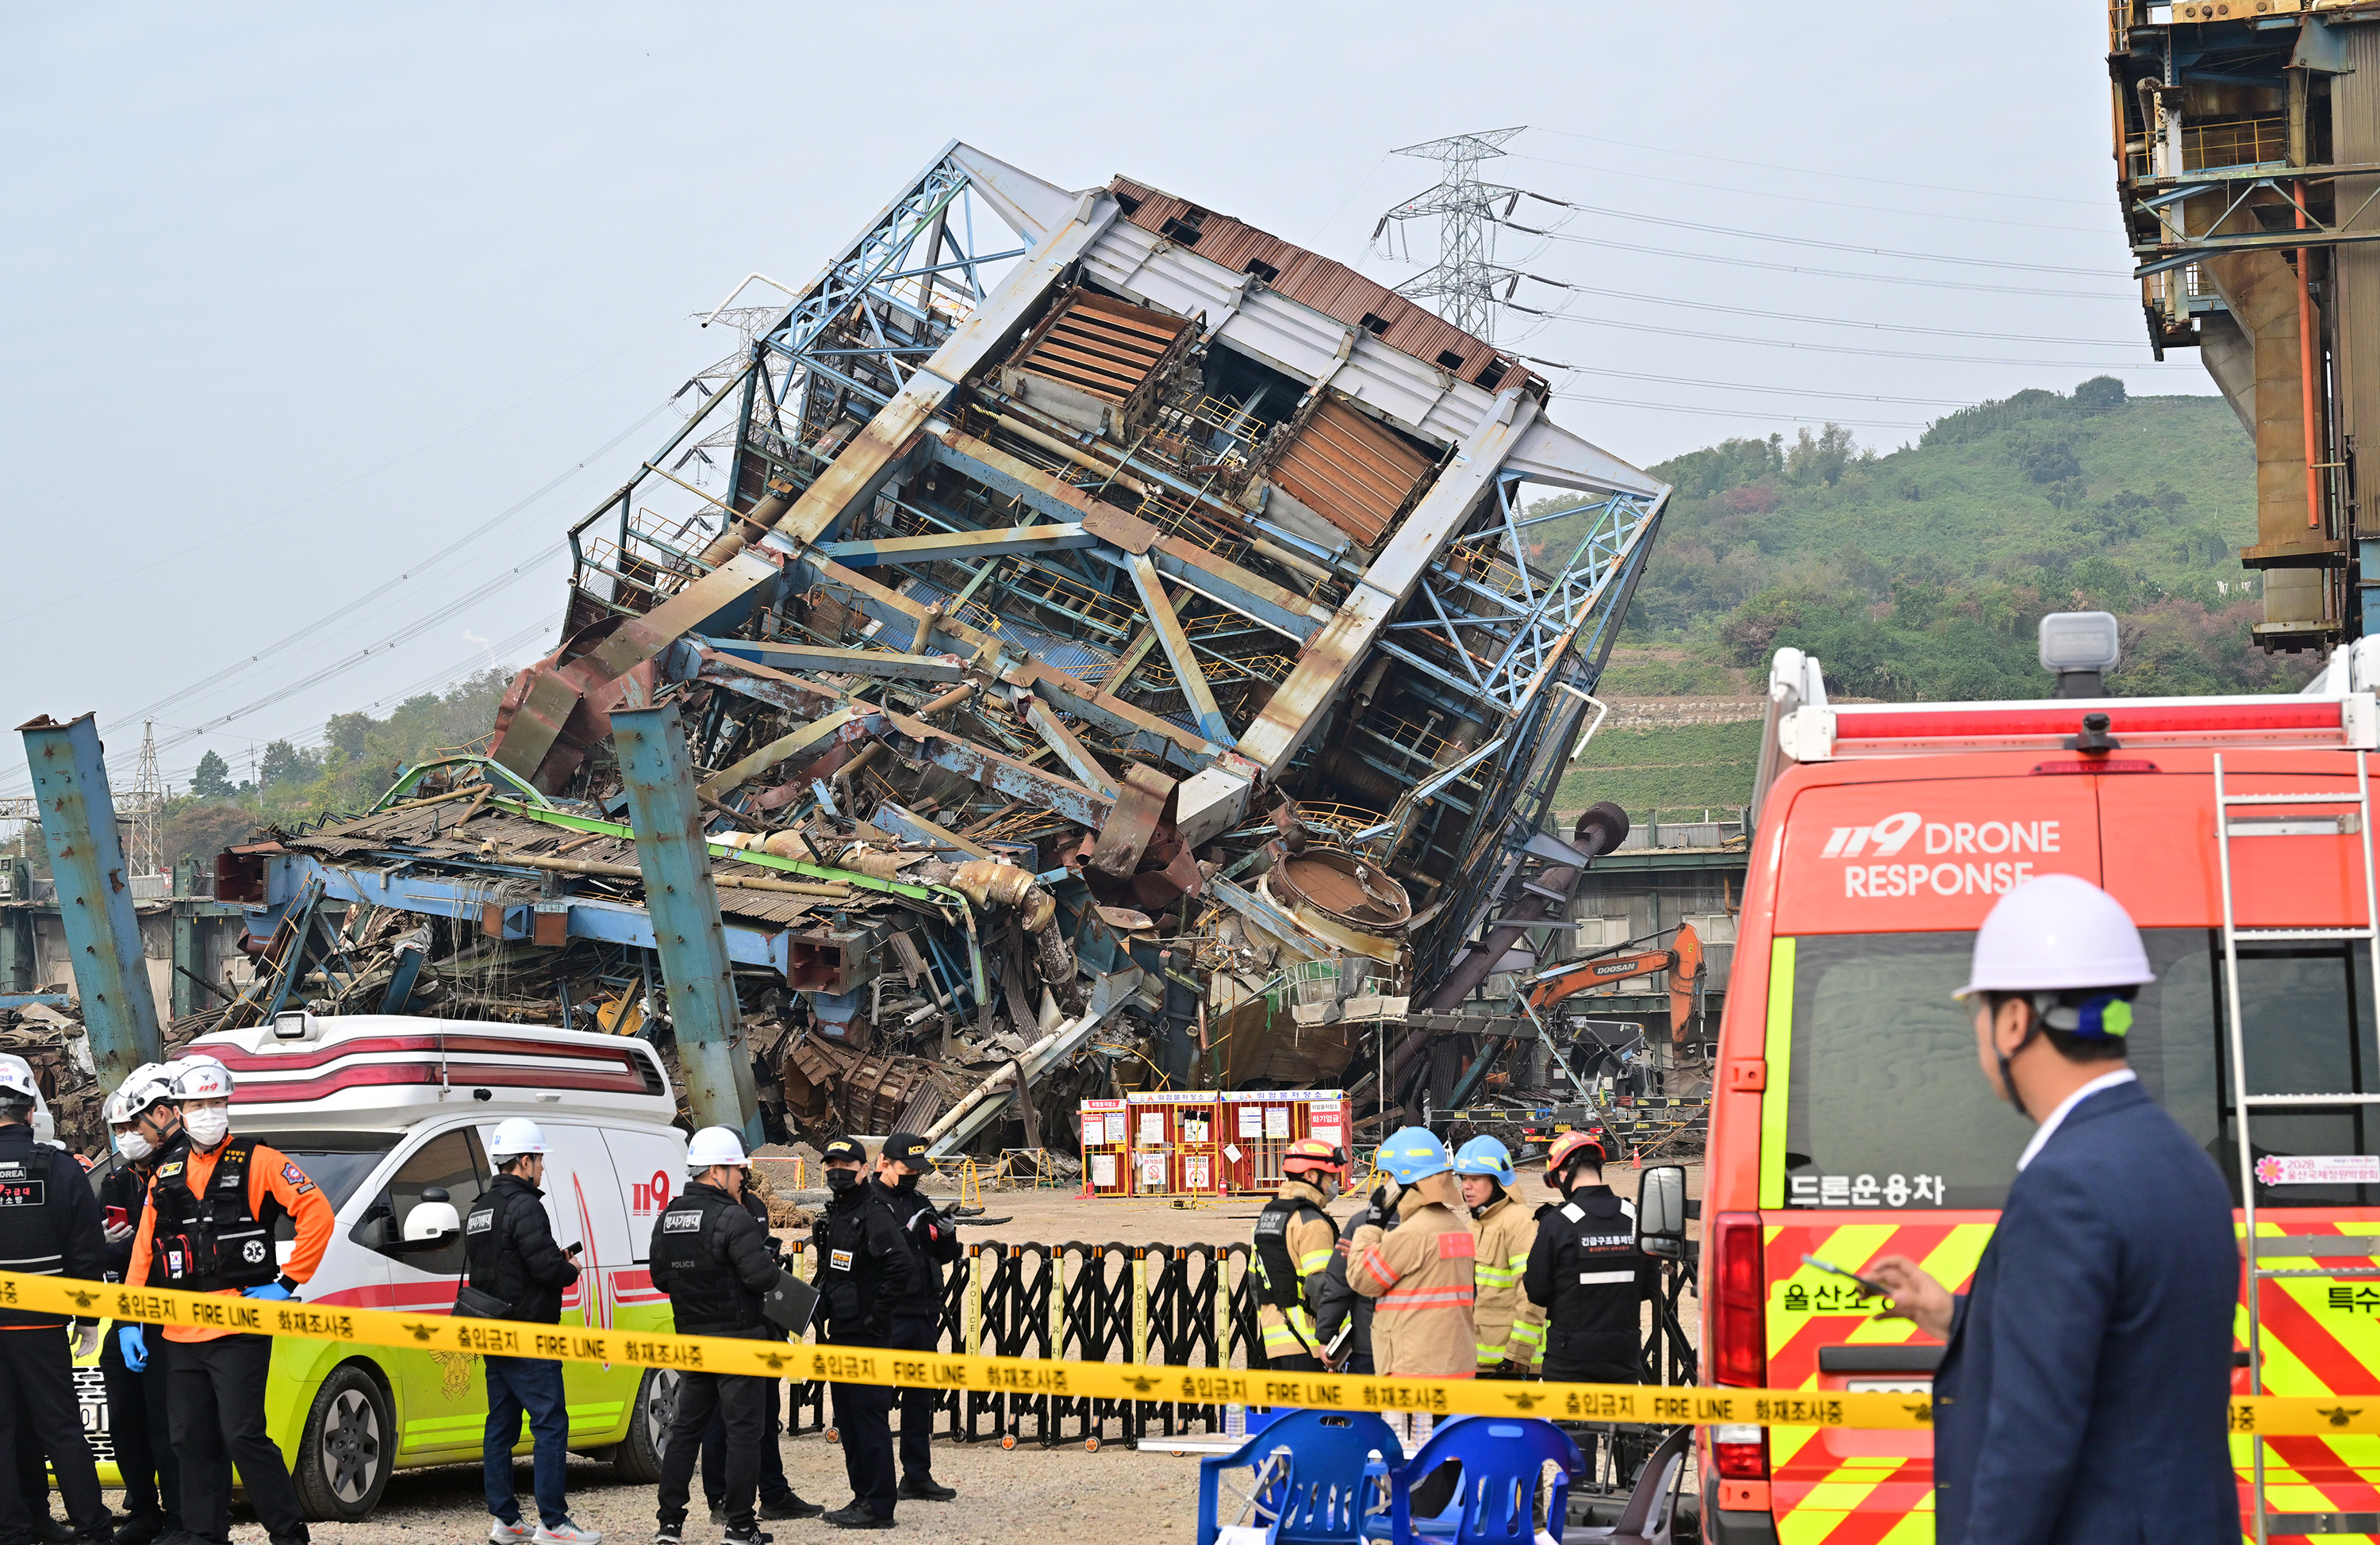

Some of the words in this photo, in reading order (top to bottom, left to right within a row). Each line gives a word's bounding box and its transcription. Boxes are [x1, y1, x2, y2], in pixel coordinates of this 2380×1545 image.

[1821, 812, 1921, 857] 119
[1925, 820, 2060, 854] DRONE
[1845, 861, 2034, 898] RESPONSE
[1596, 962, 1636, 975] DOOSAN
[198, 1083, 218, 1092] 119
[1311, 1114, 1339, 1123] 화기엄금
[2287, 1160, 2315, 1169] 2028
[4, 1187, 30, 1197] 구급대
[631, 1170, 670, 1216] 119
[1790, 1174, 1944, 1207] 드론운용차
[665, 1214, 699, 1229] 형사기동대
[117, 1293, 176, 1320] 출입금지
[193, 1303, 223, 1326] FIRE
[231, 1306, 262, 1328] LINE
[278, 1309, 354, 1338] 화재조사중
[2328, 1287, 2380, 1313] 특수
[1052, 1282, 1061, 1356] 질서유지
[458, 1325, 519, 1352] 출입금지
[536, 1335, 567, 1357] FIRE
[573, 1337, 607, 1359] LINE
[624, 1340, 704, 1367] 화재조사중
[812, 1353, 876, 1380] 출입금지
[892, 1361, 927, 1382] FIRE
[931, 1364, 966, 1385] LINE
[986, 1367, 1068, 1392] 화재조사중
[1181, 1376, 1248, 1400] 출입금지
[1266, 1383, 1301, 1403] FIRE
[1307, 1384, 1342, 1405] LINE
[1363, 1386, 1448, 1411] 화재조사중
[1565, 1393, 1634, 1417] 출입금지
[1654, 1397, 1691, 1418] FIRE
[1696, 1398, 1733, 1420] LINE
[1755, 1398, 1844, 1424] 화재조사중
